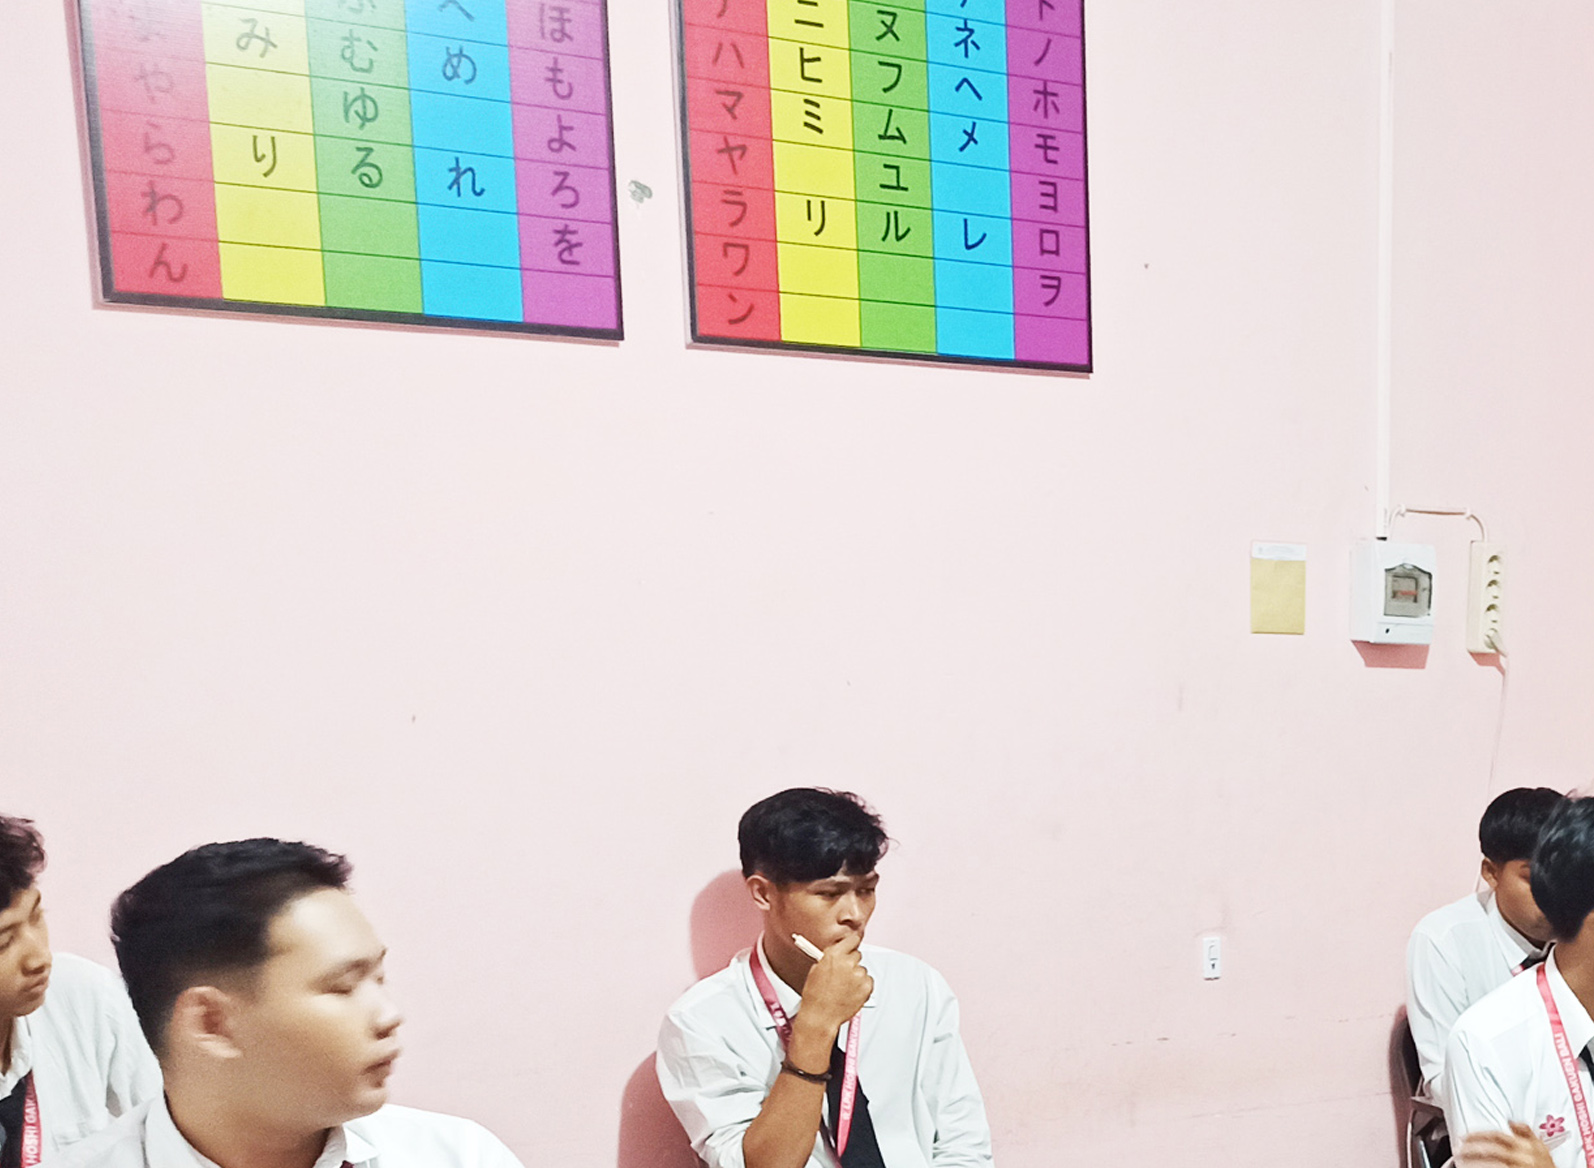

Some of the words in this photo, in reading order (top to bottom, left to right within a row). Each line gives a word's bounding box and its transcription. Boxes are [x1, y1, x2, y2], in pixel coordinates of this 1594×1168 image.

[539, 3, 574, 44] ほ
[875, 10, 901, 42] ヌ
[954, 18, 981, 59] ネ
[1034, 38, 1053, 67] ノ
[236, 18, 278, 58] み
[340, 29, 379, 73] む
[442, 45, 477, 84] め
[545, 57, 573, 100] も
[712, 42, 745, 69] ハ
[799, 47, 823, 83] ヒ
[878, 60, 903, 94] フ
[1033, 80, 1060, 119] ホ
[343, 87, 379, 130] ゆ
[547, 114, 576, 153] よ
[715, 89, 744, 120] マ
[803, 98, 824, 135] ミ
[878, 108, 907, 145] ム
[958, 121, 979, 152] メ
[1035, 133, 1060, 165] モ
[144, 121, 174, 166] ら
[252, 134, 278, 177] り
[351, 146, 383, 189] る
[447, 156, 485, 198] れ
[552, 172, 580, 209] ろ
[717, 136, 747, 176] ヤ
[879, 163, 909, 192] ユ
[1038, 181, 1059, 213] ヨ
[142, 180, 184, 226] わ
[554, 224, 584, 265] を
[721, 190, 748, 228] ラ
[806, 199, 827, 237] リ
[881, 210, 911, 242] ル
[963, 218, 987, 251] レ
[1039, 228, 1060, 258] ロ
[149, 243, 187, 283] ん
[722, 242, 750, 277] ワ
[1041, 275, 1062, 307] ヲ
[727, 293, 754, 325] ン
[24, 1125, 37, 1163] HOSHI
[1574, 1102, 1591, 1136] HOSHI
